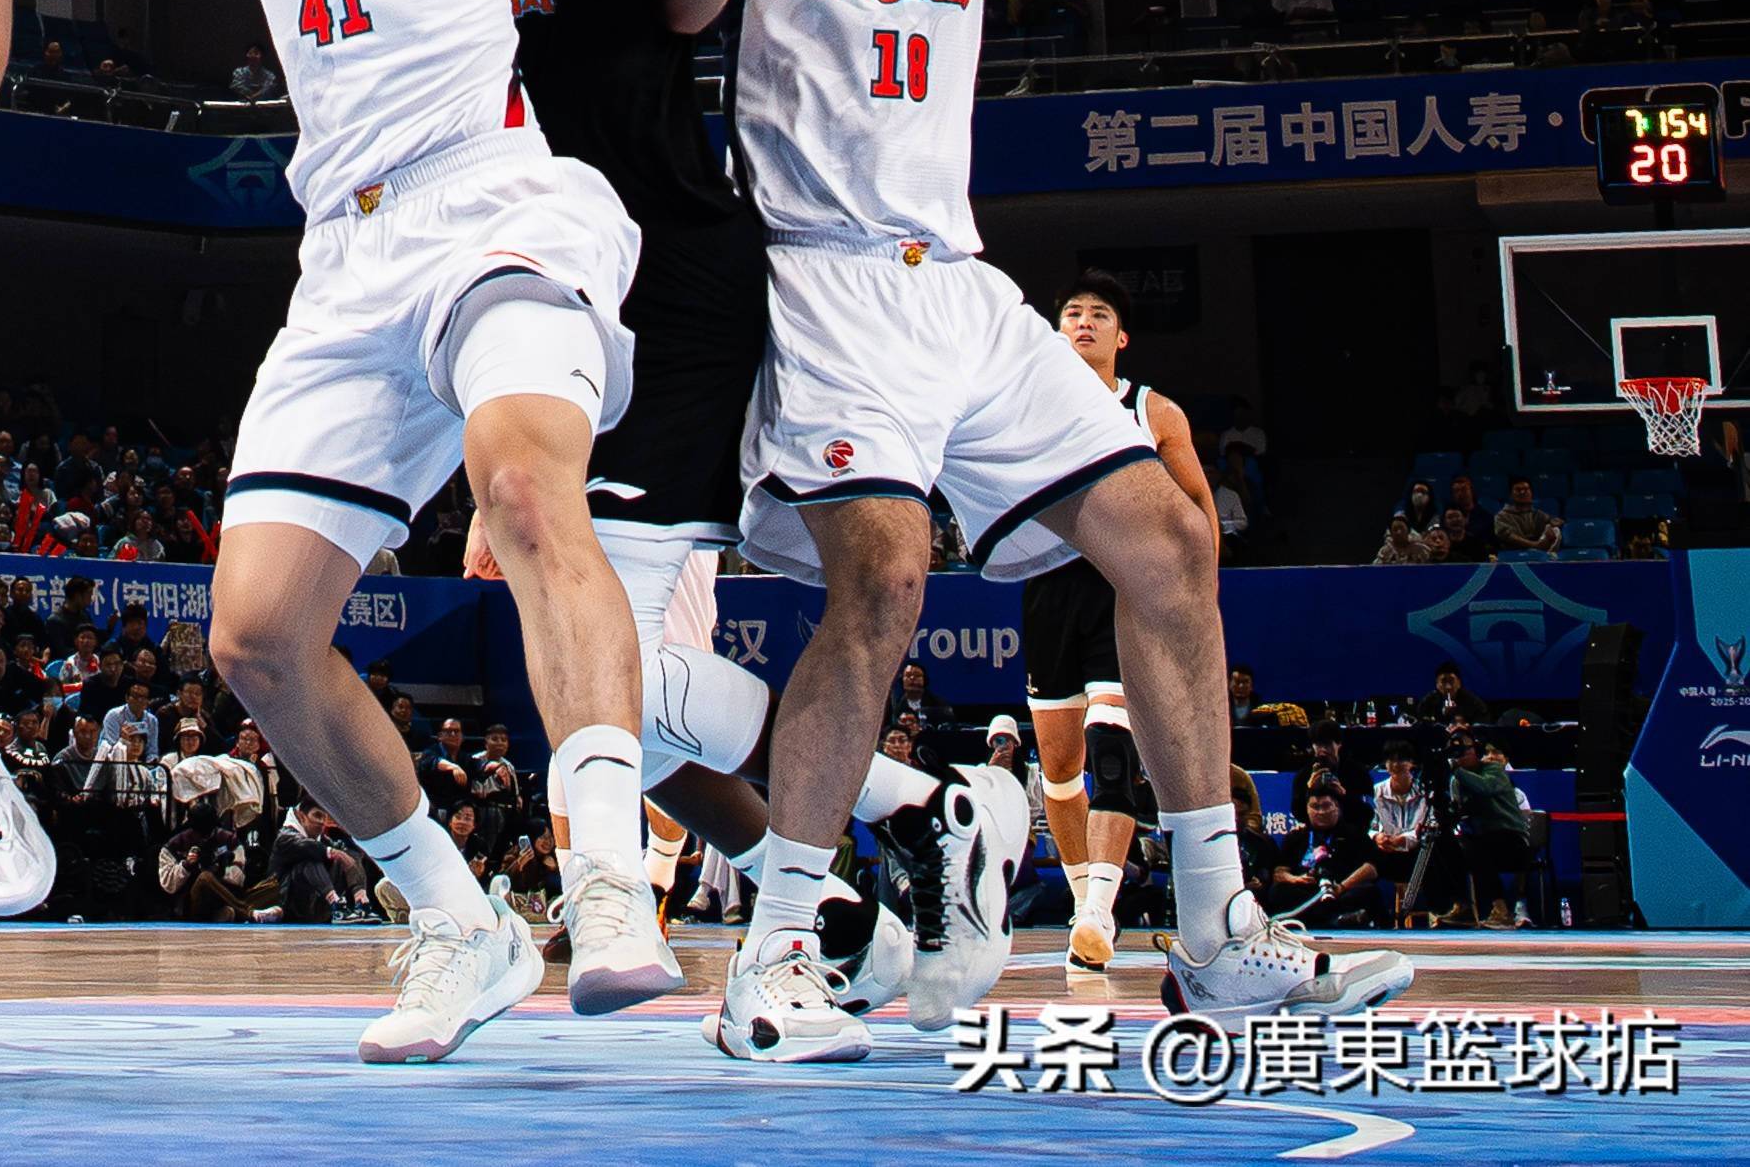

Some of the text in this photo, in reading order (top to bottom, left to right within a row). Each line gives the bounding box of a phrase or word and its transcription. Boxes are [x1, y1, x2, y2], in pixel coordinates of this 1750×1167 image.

[870, 29, 930, 102] 18
[1630, 144, 1689, 183] 20
[340, 591, 407, 631] 赛区)
[909, 627, 1020, 668] roup
